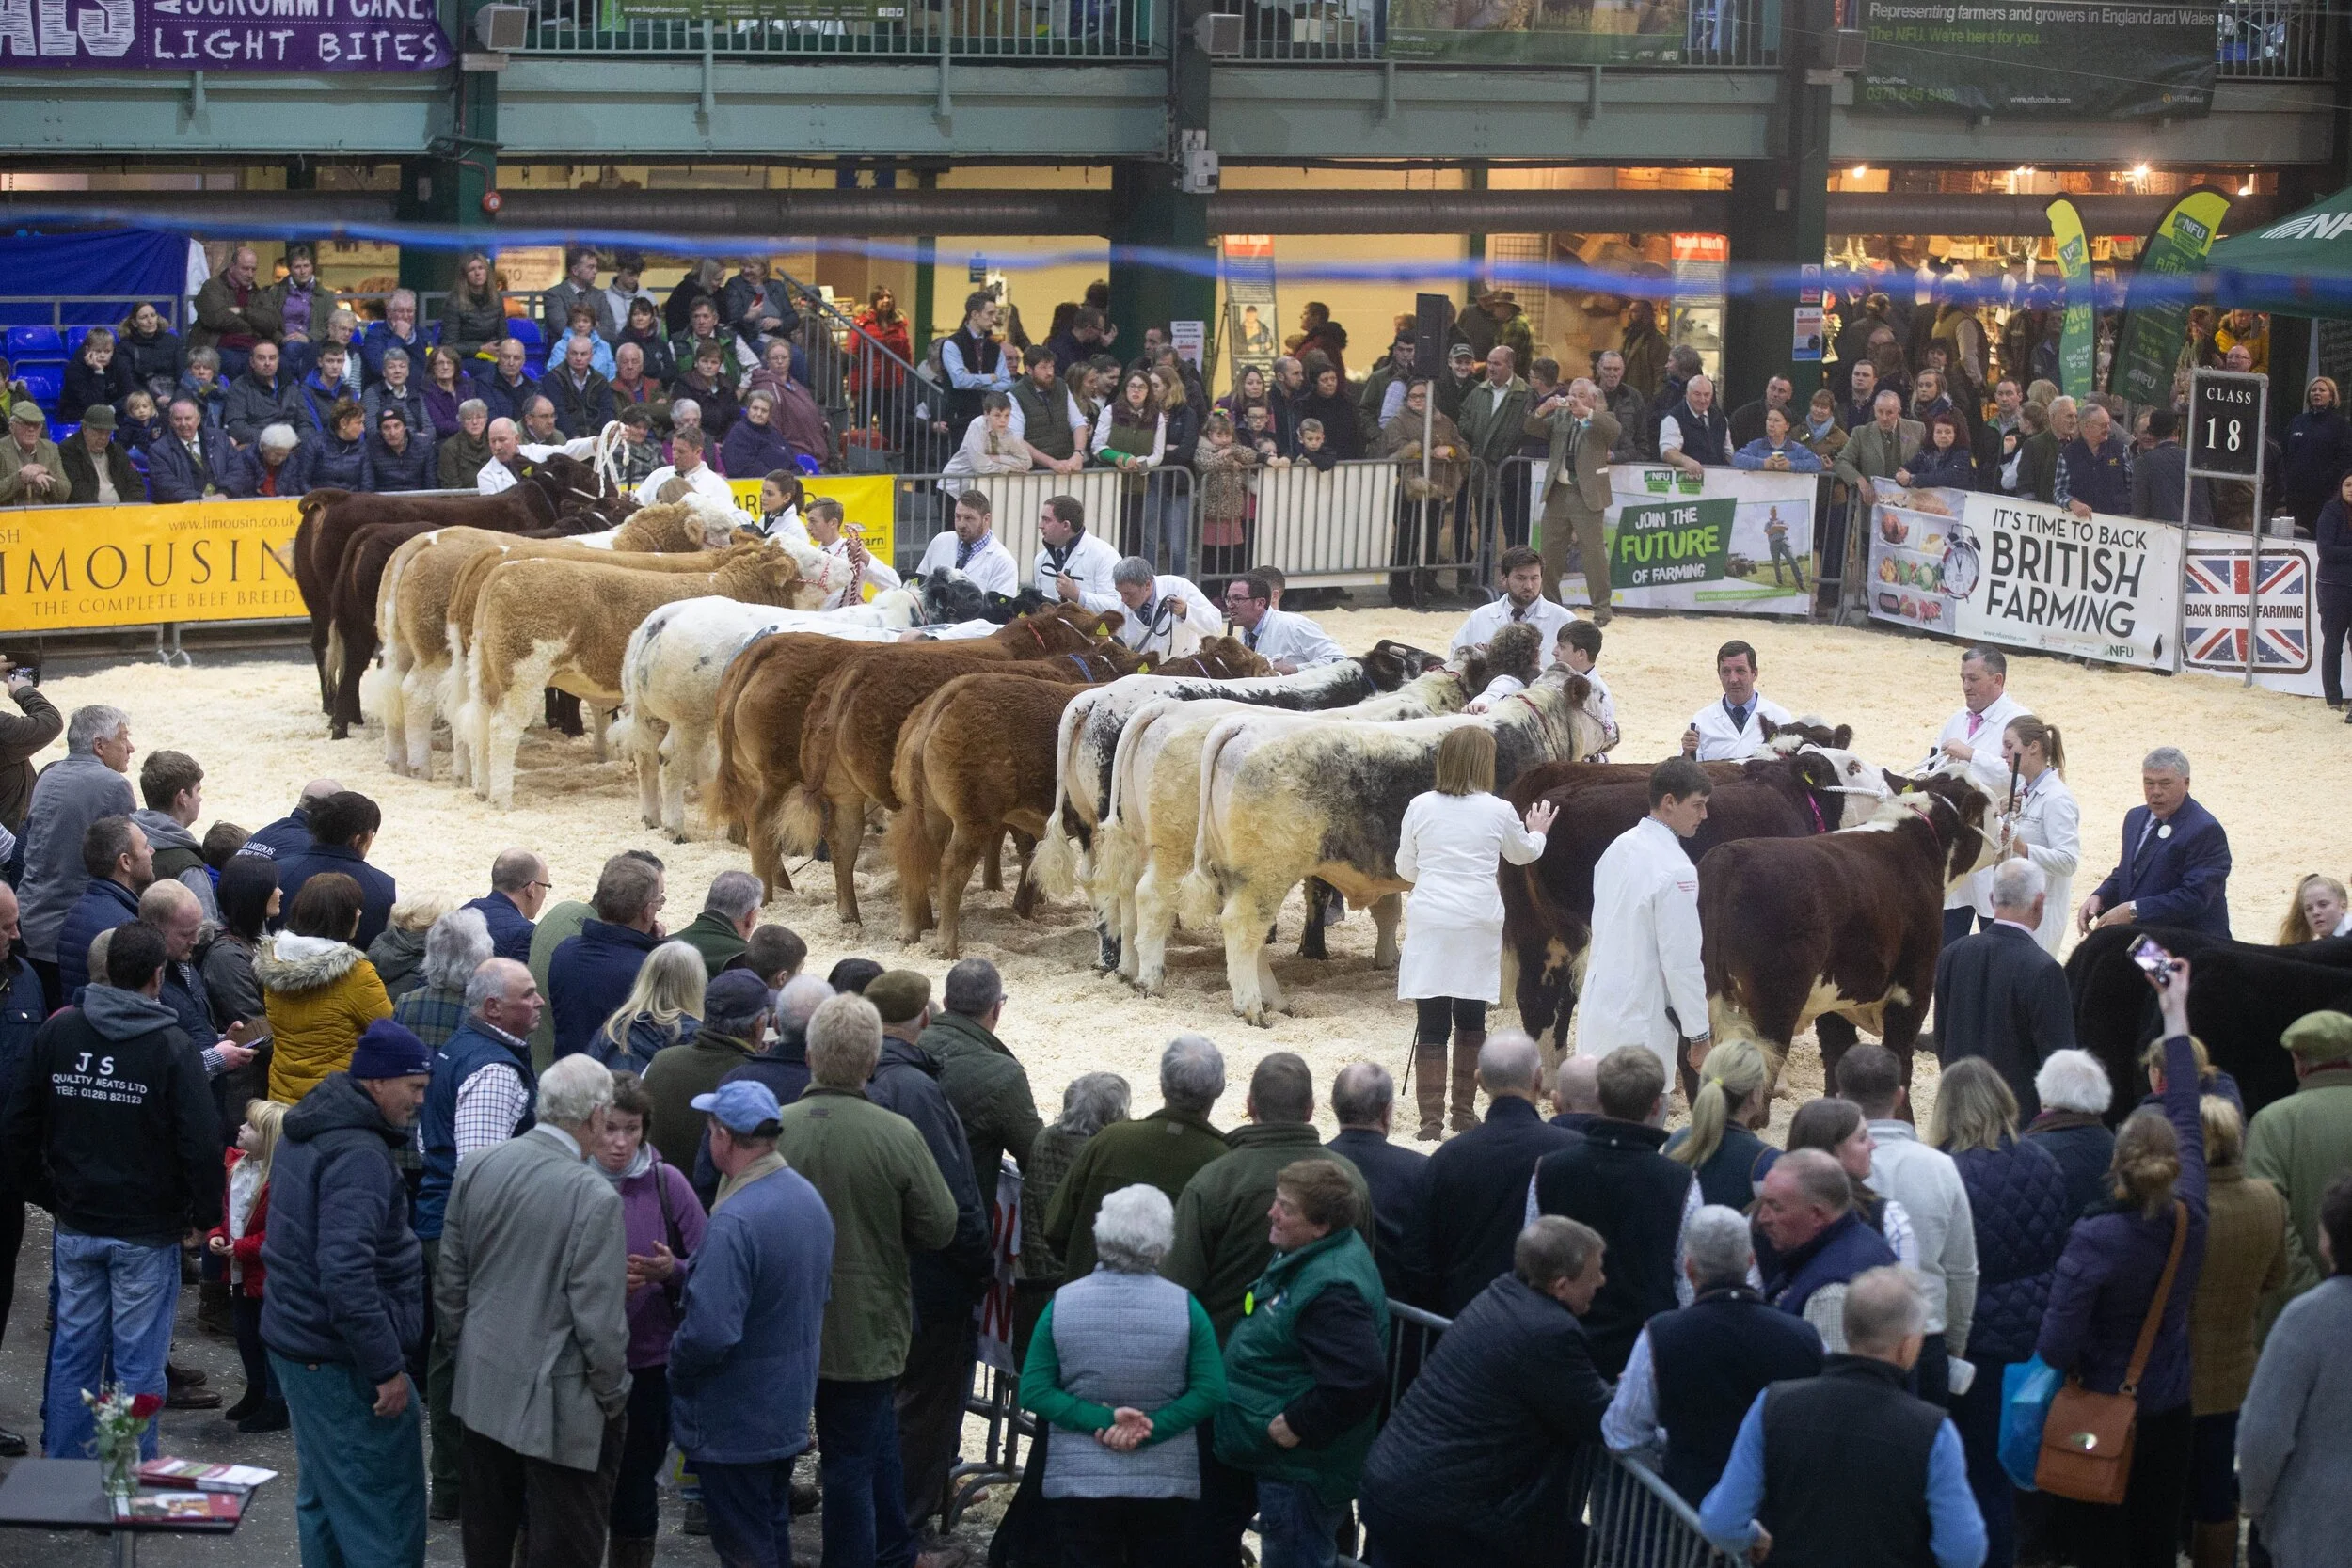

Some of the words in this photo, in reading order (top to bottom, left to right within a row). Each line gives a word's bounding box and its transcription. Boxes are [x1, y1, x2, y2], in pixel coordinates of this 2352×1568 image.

[1869, 2, 1956, 23] Representing
[1958, 5, 2006, 21] farmers
[2009, 7, 2032, 22] and
[2035, 8, 2085, 24] growers
[2089, 8, 2099, 23] in
[2102, 8, 2151, 26] England
[2153, 10, 2176, 24] and
[2179, 10, 2215, 25] Wales
[155, 28, 294, 60] LIGHT
[319, 31, 437, 62] BITES
[1869, 26, 1892, 40] The
[1930, 29, 1964, 42] We're
[1966, 29, 1994, 43] here
[1998, 29, 2013, 43] for
[2183, 217, 2206, 240] NFU
[2206, 387, 2251, 404] CLASS
[2205, 417, 2241, 451] 18
[1651, 472, 1671, 481] NFU
[168, 515, 296, 531] www.limousin.co.uk
[1635, 511, 1666, 530] JOIN
[1670, 506, 1698, 525] THE
[1993, 508, 2021, 531] IT'S
[2026, 514, 2066, 538] TIME
[2071, 520, 2094, 542] TO
[2099, 525, 2147, 550] BACK
[1620, 525, 1721, 564] FUTURE
[1632, 568, 1648, 584] OF
[1652, 563, 1706, 582] FARMING
[1991, 531, 2146, 599] BRITISH
[32, 600, 69, 616] THE
[79, 594, 178, 614] COMPLETE
[187, 591, 228, 608] BEEF
[237, 589, 296, 606] BREED
[1986, 578, 2136, 639] FARMING
[2185, 604, 2212, 617] BACK
[2256, 605, 2304, 619] FARMING
[2109, 644, 2134, 658] NFU
[75, 1052, 93, 1073] J
[98, 1056, 115, 1076] S
[52, 1073, 93, 1085] QUALITY
[95, 1076, 126, 1090] MEATS
[128, 1082, 148, 1095] LTD
[81, 1087, 107, 1100] 01283
[110, 1093, 142, 1105] 821123
